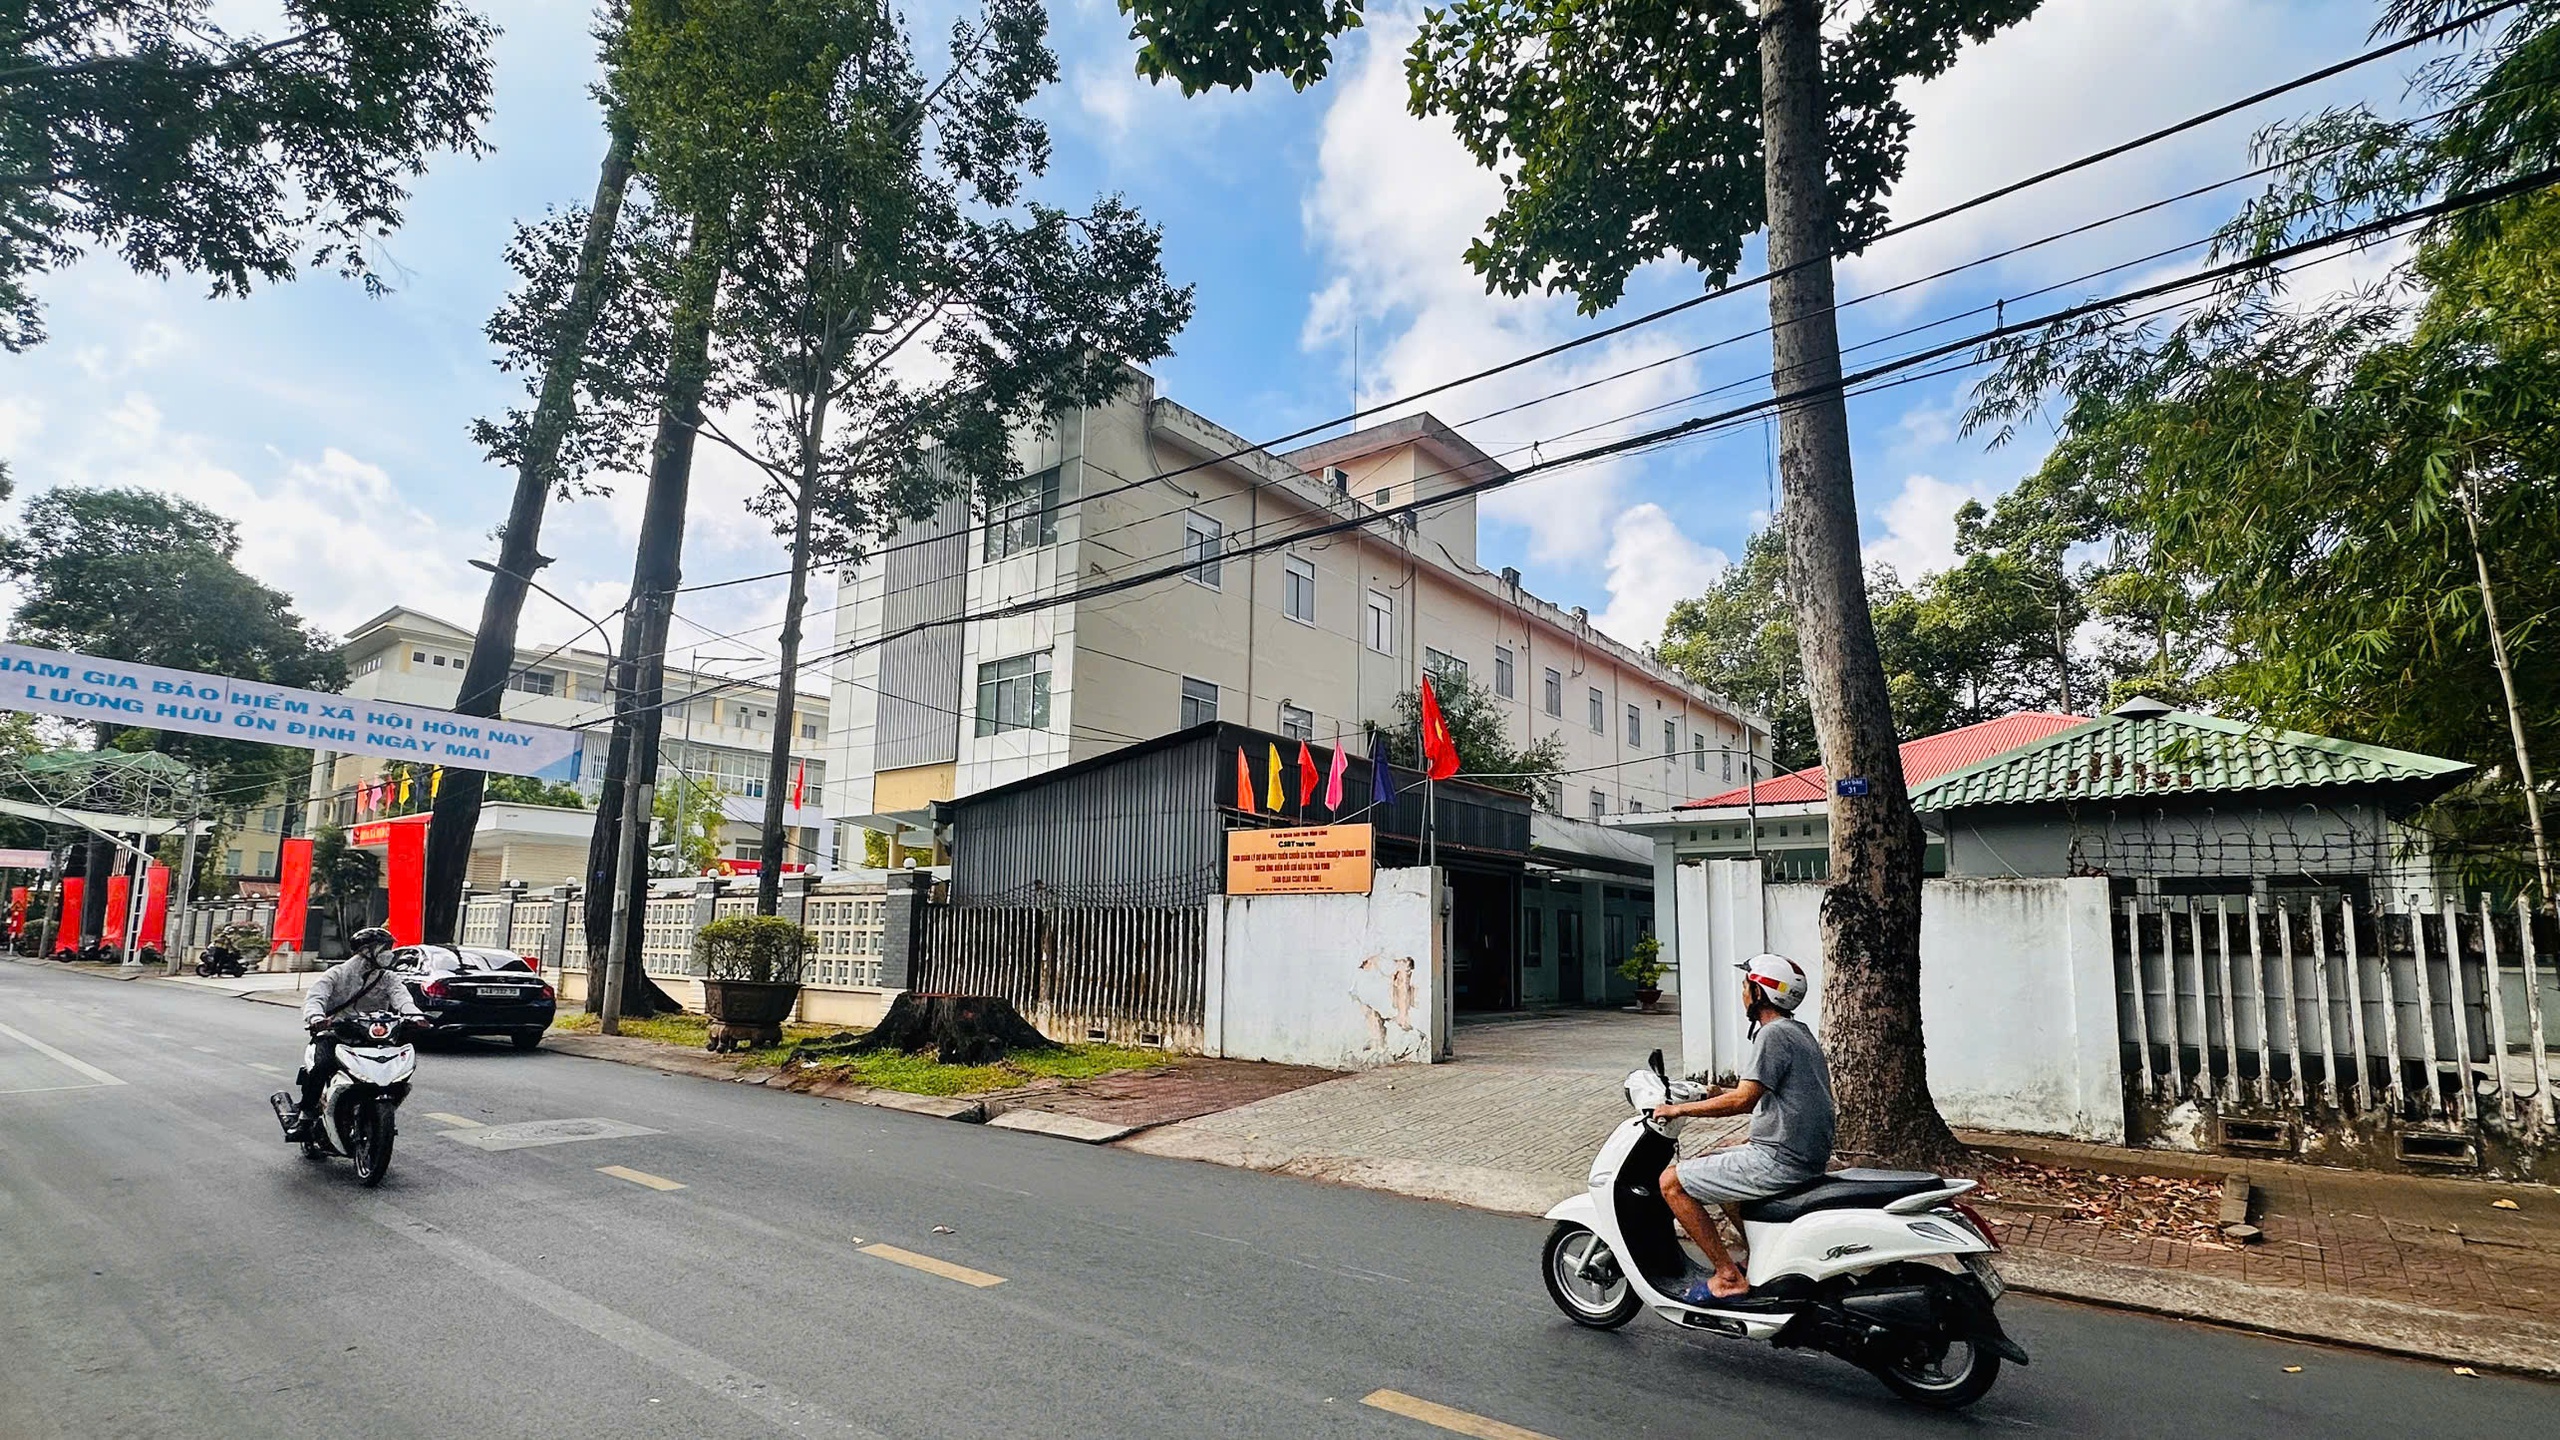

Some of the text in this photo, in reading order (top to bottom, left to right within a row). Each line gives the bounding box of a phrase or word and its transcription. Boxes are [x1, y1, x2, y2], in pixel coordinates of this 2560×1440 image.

[25, 685, 490, 760] LƯƠNG HƯU ỔN ĐỊNH NGÀY MAI
[83, 670, 139, 690] GIA
[152, 679, 220, 701] BẢO
[231, 692, 309, 715] HIỂM
[319, 704, 355, 721] XÃ
[366, 711, 412, 730] HỘI
[422, 720, 479, 739] HÔM
[488, 730, 535, 747] NAY
